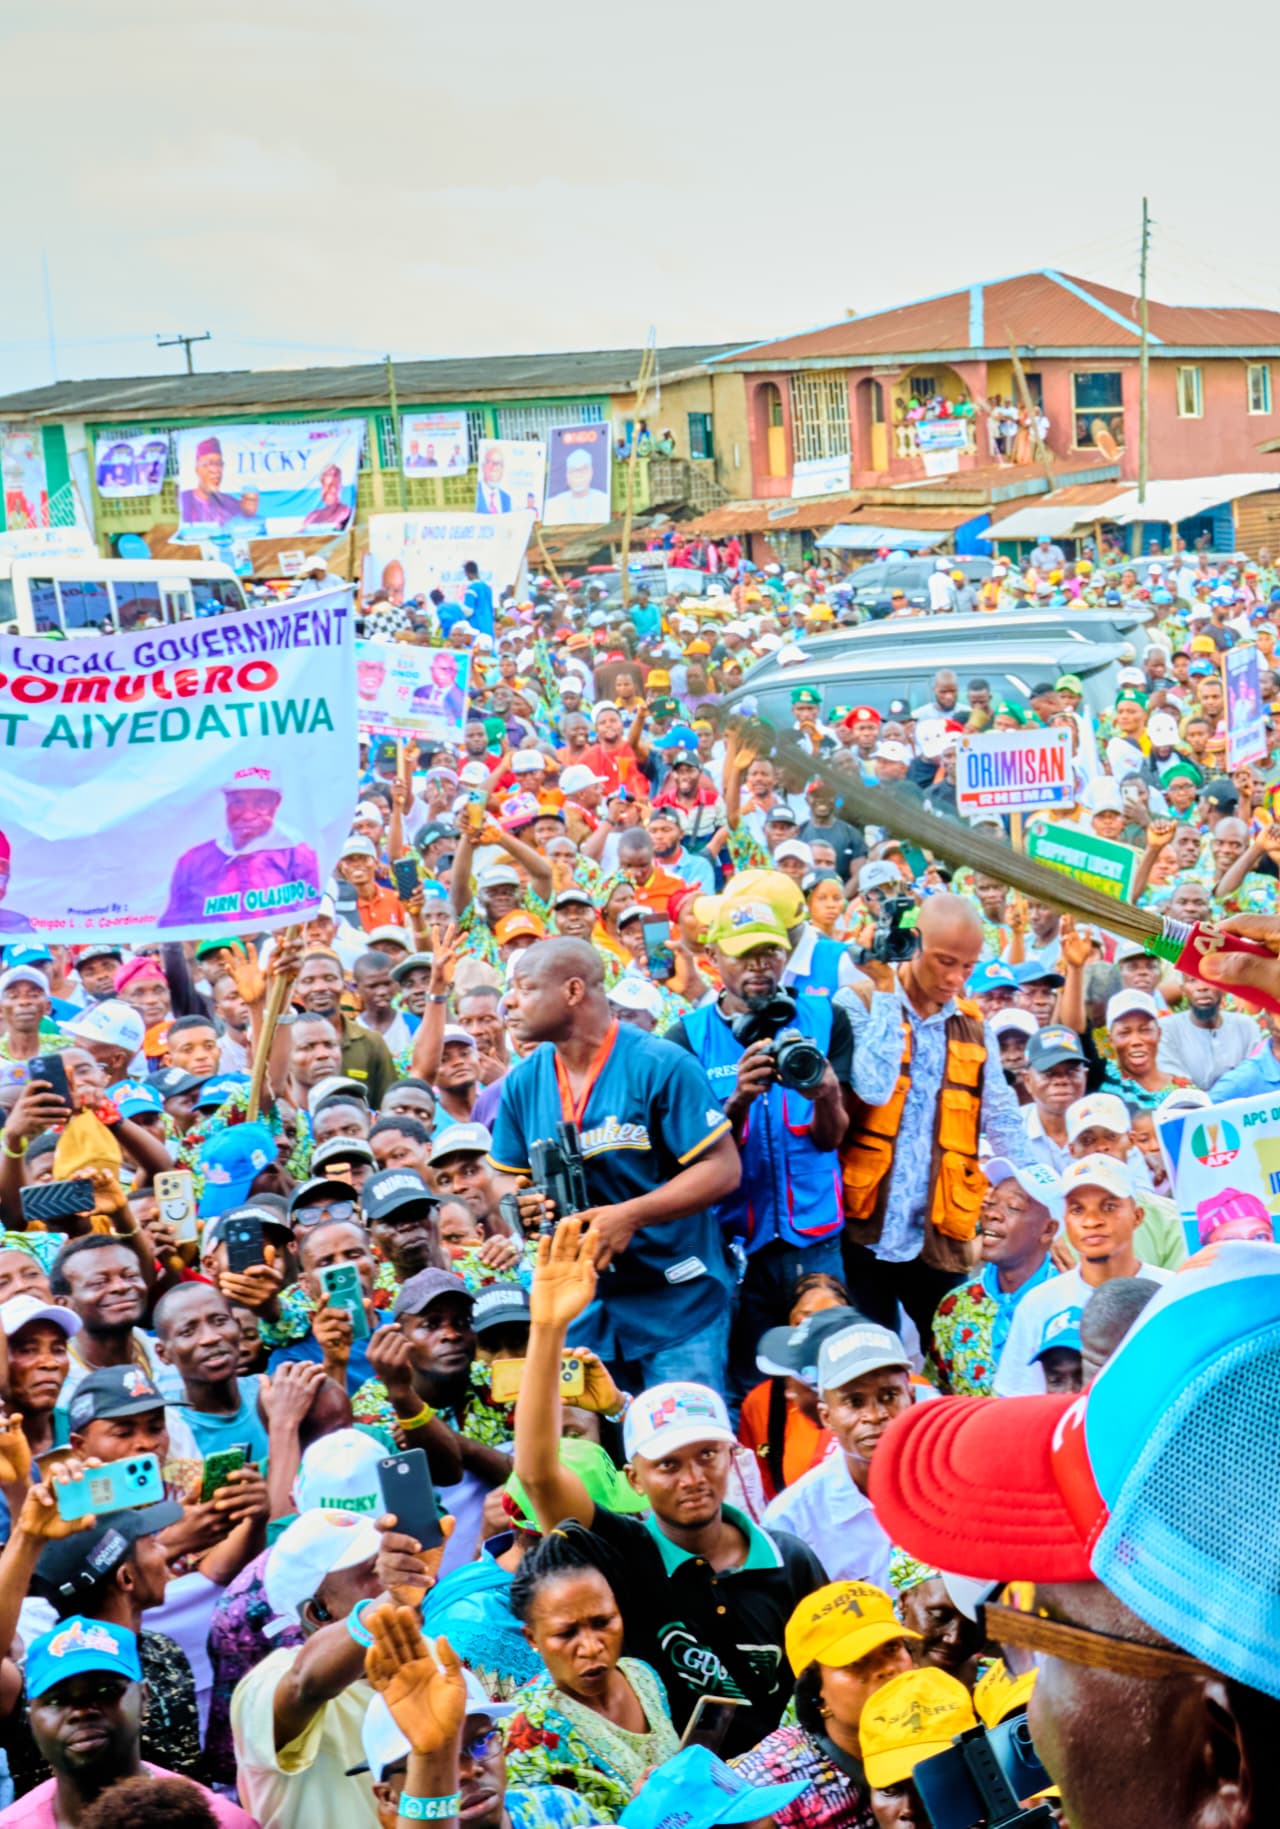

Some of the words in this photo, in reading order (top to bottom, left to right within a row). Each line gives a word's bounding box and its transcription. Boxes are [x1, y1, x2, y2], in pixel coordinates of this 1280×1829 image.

[13, 647, 126, 676] LOCAL
[133, 608, 348, 669] GOVERNMENT
[41, 697, 335, 749] AIYEDATIWA
[967, 746, 1065, 789] ORIMISAN
[1243, 1110, 1268, 1128] APC
[1206, 1149, 1238, 1168] APC
[319, 1492, 378, 1512] LUCKY
